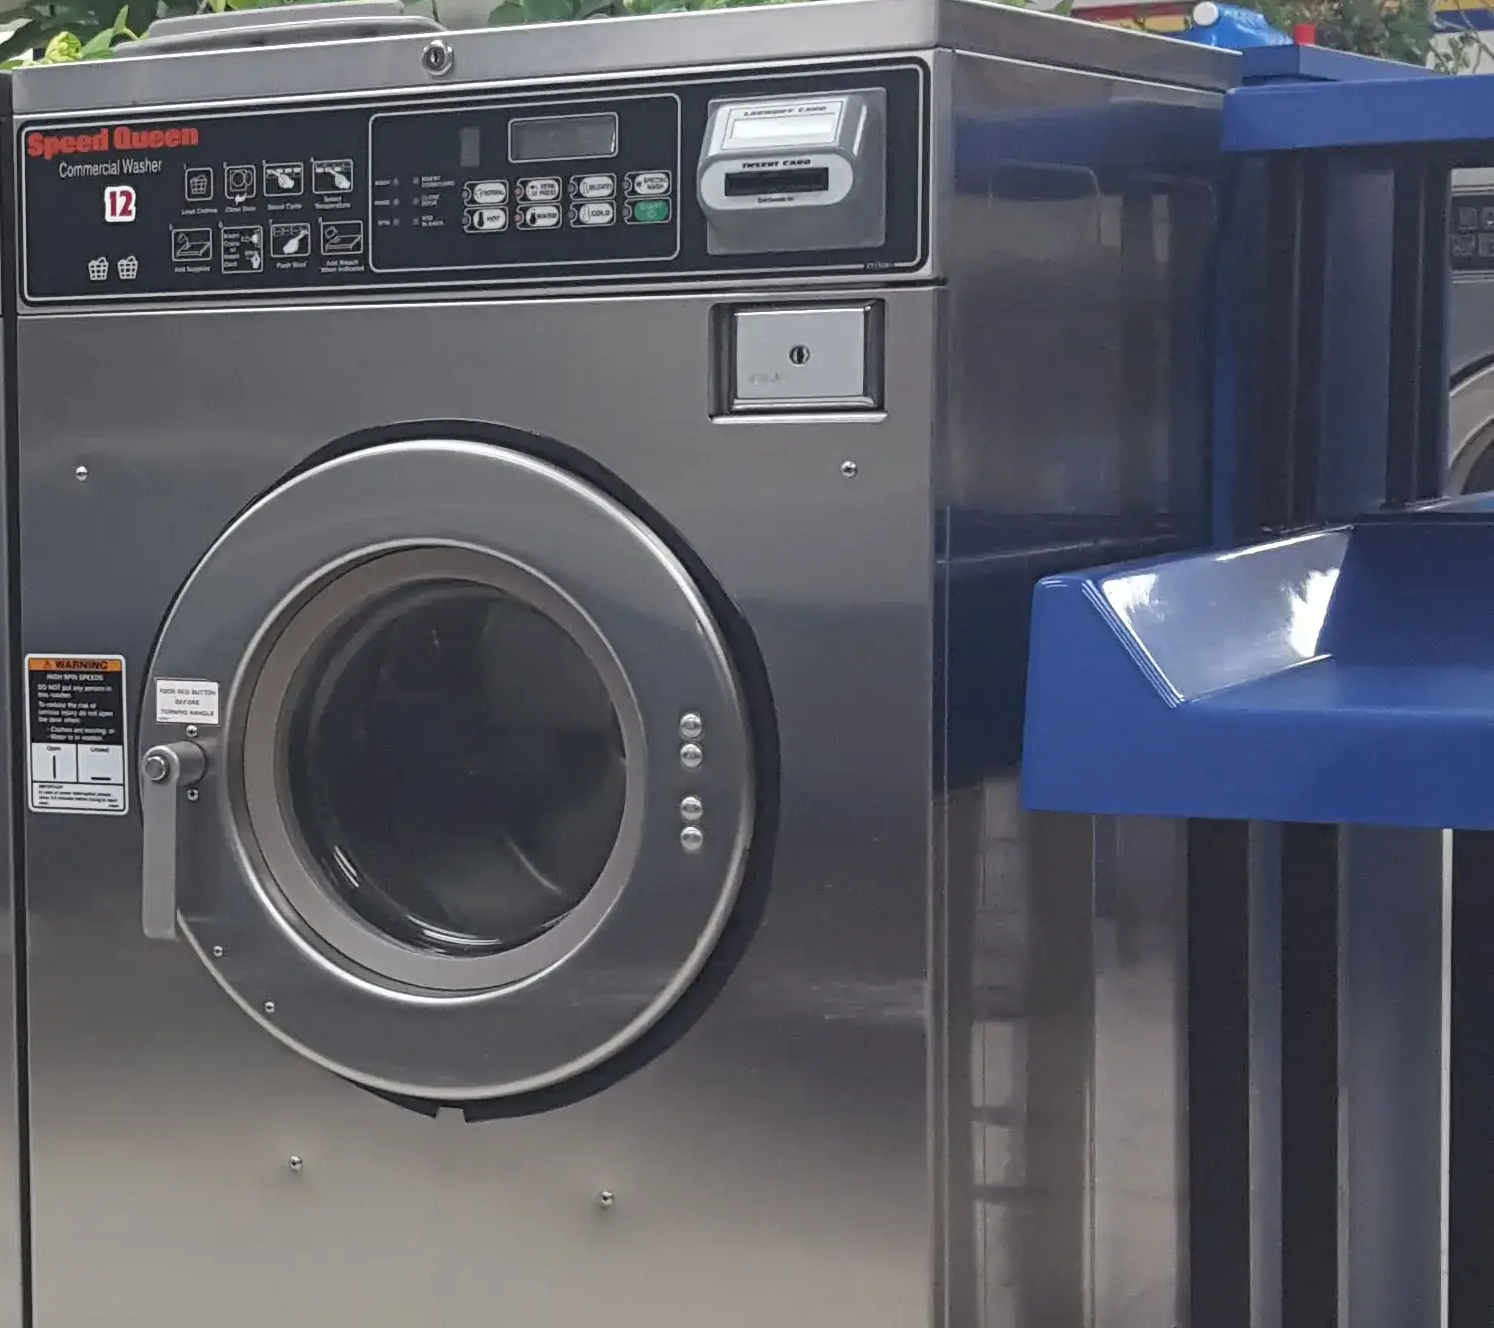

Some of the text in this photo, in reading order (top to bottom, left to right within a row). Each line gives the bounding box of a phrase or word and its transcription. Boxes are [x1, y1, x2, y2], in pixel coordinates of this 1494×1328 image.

[27, 126, 199, 160] Speed Queen
[59, 159, 163, 179] Commercial Washer
[109, 190, 133, 217] 12
[55, 660, 109, 670] WARNING
